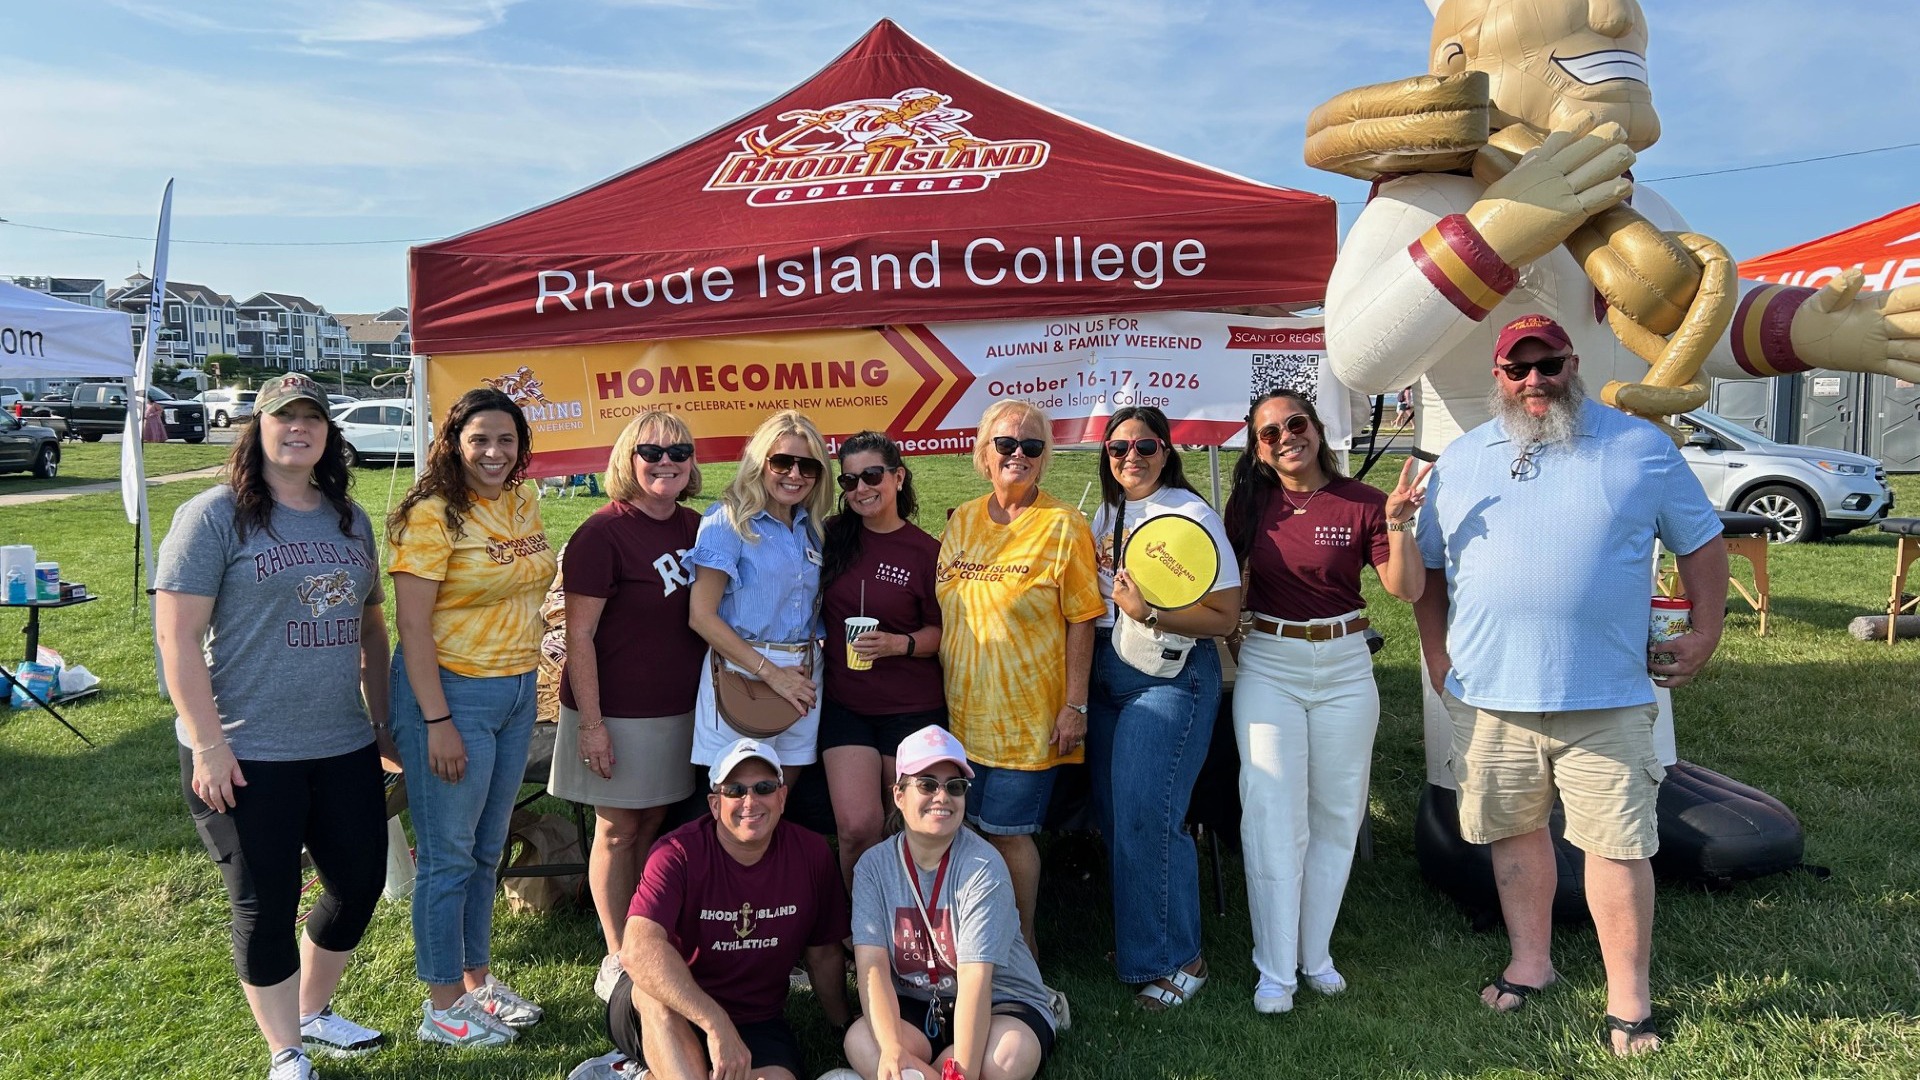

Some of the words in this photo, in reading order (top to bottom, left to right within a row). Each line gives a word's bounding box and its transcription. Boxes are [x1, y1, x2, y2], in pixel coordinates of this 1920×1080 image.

[774, 178, 963, 201] COLLEGE
[536, 267, 733, 313] Rhode
[757, 240, 941, 297] Island
[964, 236, 1206, 290] College
[1044, 322, 1080, 338] JOIN
[1086, 319, 1104, 333] US
[1109, 318, 1139, 332] FOR
[0, 327, 44, 357] om
[986, 342, 1048, 358] ALUMNI
[1053, 340, 1064, 352] &
[1069, 334, 1120, 350] FAMILY
[1125, 334, 1202, 349] WEEKEND
[1234, 333, 1267, 343] SCAN
[1269, 333, 1286, 343] TO
[596, 359, 889, 400] HOMECOMING
[988, 376, 1068, 397] October
[1077, 370, 1139, 390] 16-17,
[1148, 371, 1200, 390] 2026
[600, 402, 673, 419] RECONNECT
[685, 400, 746, 411] CELEBRATE
[757, 399, 789, 410] MAKE
[794, 398, 821, 409] NEW
[825, 395, 888, 407] MEMORIES
[1020, 394, 1063, 409] hode
[1068, 390, 1107, 406] Island
[1112, 390, 1170, 409] College
[536, 421, 584, 432] WEEKEND
[498, 538, 528, 550] RHODE
[514, 542, 550, 557] COLLEGE
[254, 542, 315, 582] RHODE
[879, 563, 911, 577] RHODE
[952, 560, 989, 572] RHODE
[990, 565, 1030, 574] ISLAND
[1158, 547, 1177, 565] RHODE
[1175, 562, 1196, 582] ISLAND
[1159, 556, 1183, 578] COLLEGE
[652, 549, 688, 598] R
[875, 574, 907, 587] COLLEGE
[877, 568, 909, 582] ISLAND
[960, 571, 1005, 582] COLLEGE
[287, 618, 360, 647] COLLEGE
[700, 909, 738, 921] RHODE
[756, 905, 797, 919] ISLAND
[711, 937, 779, 951] ATHLETICS
[903, 929, 946, 940] RHE
[903, 941, 947, 952] ISLD
